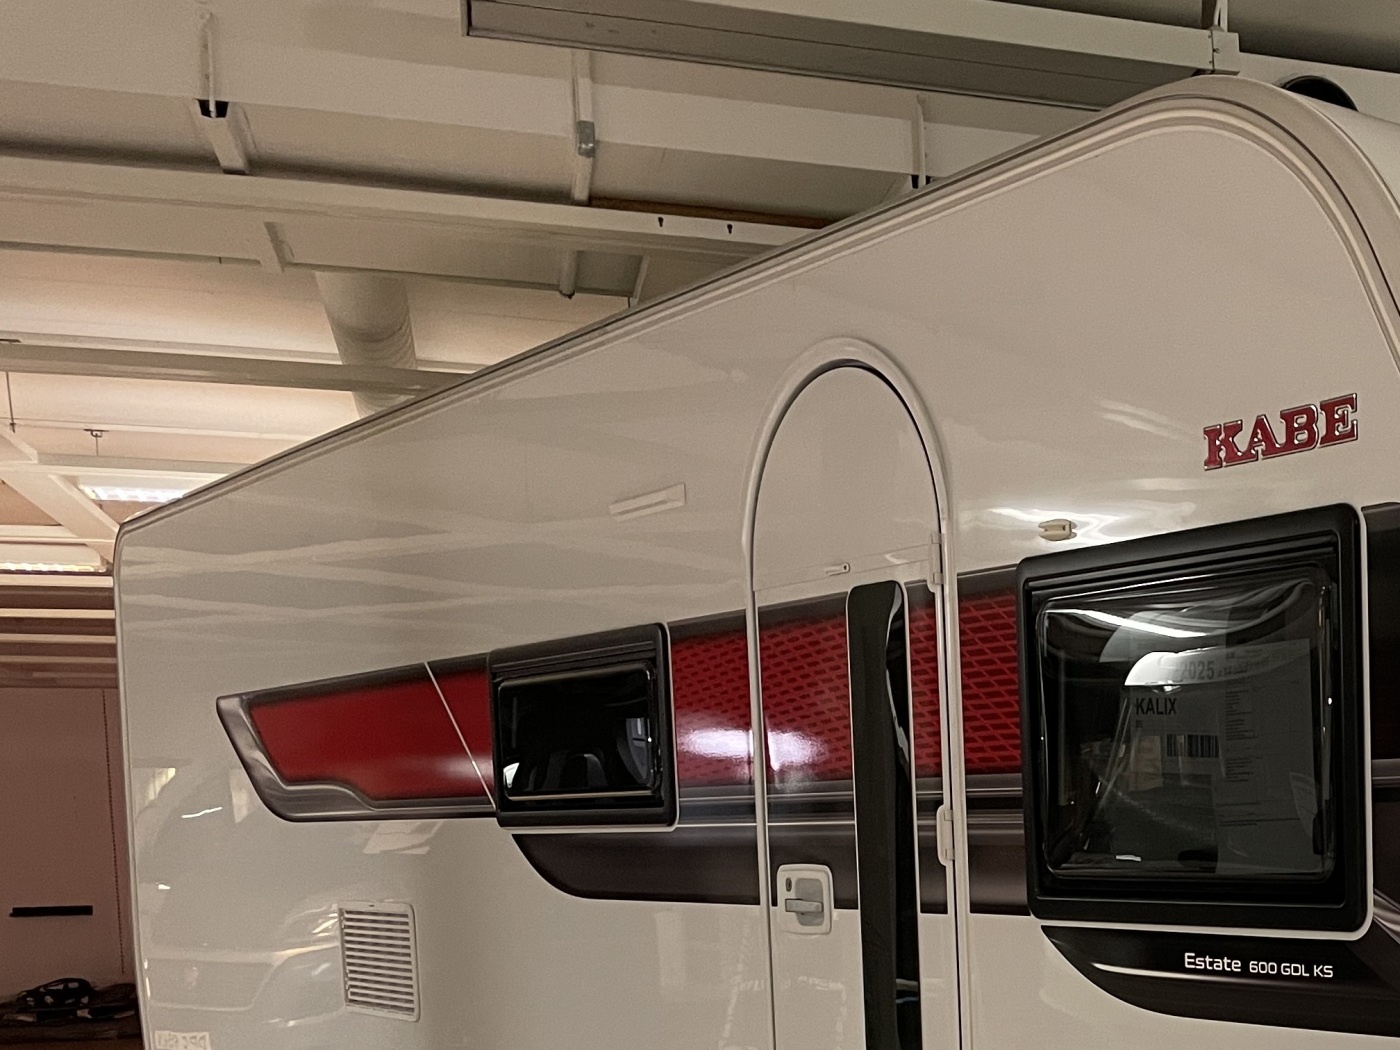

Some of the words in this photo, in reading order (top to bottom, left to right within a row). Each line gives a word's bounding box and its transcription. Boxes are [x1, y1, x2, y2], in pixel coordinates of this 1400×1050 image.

[1203, 392, 1358, 471] KABE
[1135, 697, 1177, 715] KALIX
[1184, 952, 1242, 972] Estate
[1249, 960, 1278, 974] 600
[1280, 963, 1310, 977] GDL
[1313, 965, 1334, 978] KS
